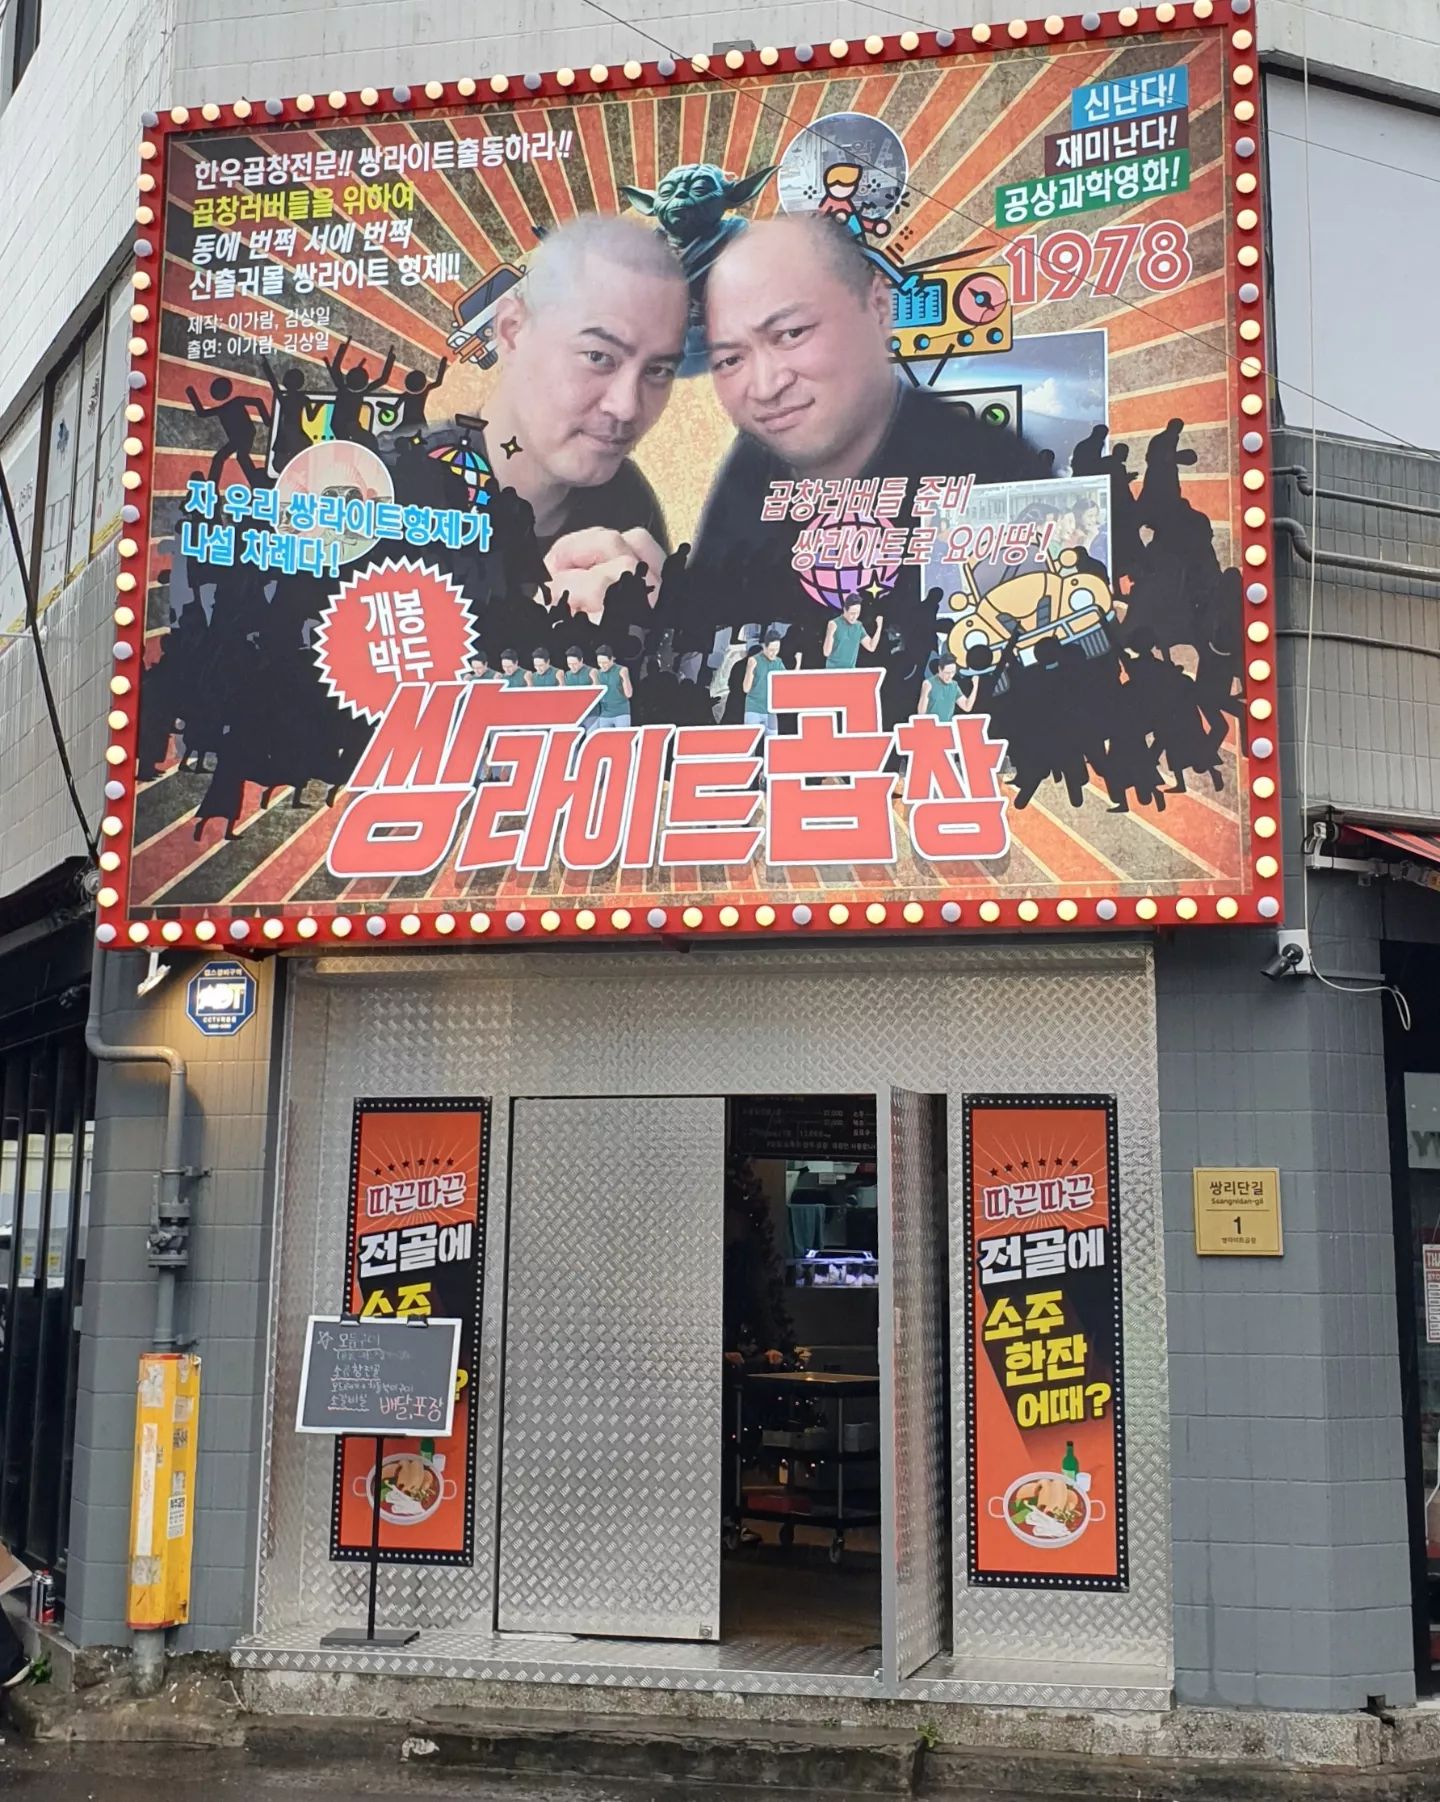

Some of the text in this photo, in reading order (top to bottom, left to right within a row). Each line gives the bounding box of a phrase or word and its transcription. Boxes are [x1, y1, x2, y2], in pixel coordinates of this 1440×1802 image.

[1083, 73, 1175, 122] 신난다!
[195, 130, 573, 191] 한우곱창전문!! 쌍라이트출동하라!!
[1055, 115, 1178, 169] 재미난다!
[192, 181, 414, 227] 곱창러버들을 위하여
[1003, 156, 1180, 223] 공상과학영화!
[191, 218, 413, 265] 동에 번쩍 서에 번쩍
[1002, 219, 1193, 306] 1978
[189, 253, 461, 300] 신출귀몰 쌍라이트 형제!!
[187, 306, 330, 335] 제작: 이가람, 김상일
[187, 331, 329, 360] 출연: 이가람, 김상일
[185, 480, 493, 552] 자 우리 쌍라이트형제가
[760, 474, 976, 522] 곱창러버들 준비
[181, 521, 341, 578] 나설 차례다!
[791, 522, 1054, 572] 쌍라이트로 요이땅!
[360, 589, 425, 636] 개봉
[367, 637, 434, 682] 박두
[326, 667, 1010, 878] 쌍라이트곱창
[367, 1172, 467, 1218] 따끈따끈
[984, 1173, 1095, 1221] 따끈따끈
[1209, 1180, 1264, 1196] 쌍리단길
[1233, 1216, 1242, 1234] 1
[359, 1222, 473, 1279] 전골에
[979, 1227, 1105, 1285] 전골에
[984, 1290, 1065, 1341] 소주
[1005, 1333, 1088, 1387] 한잔
[1017, 1382, 1112, 1429] 어때?
